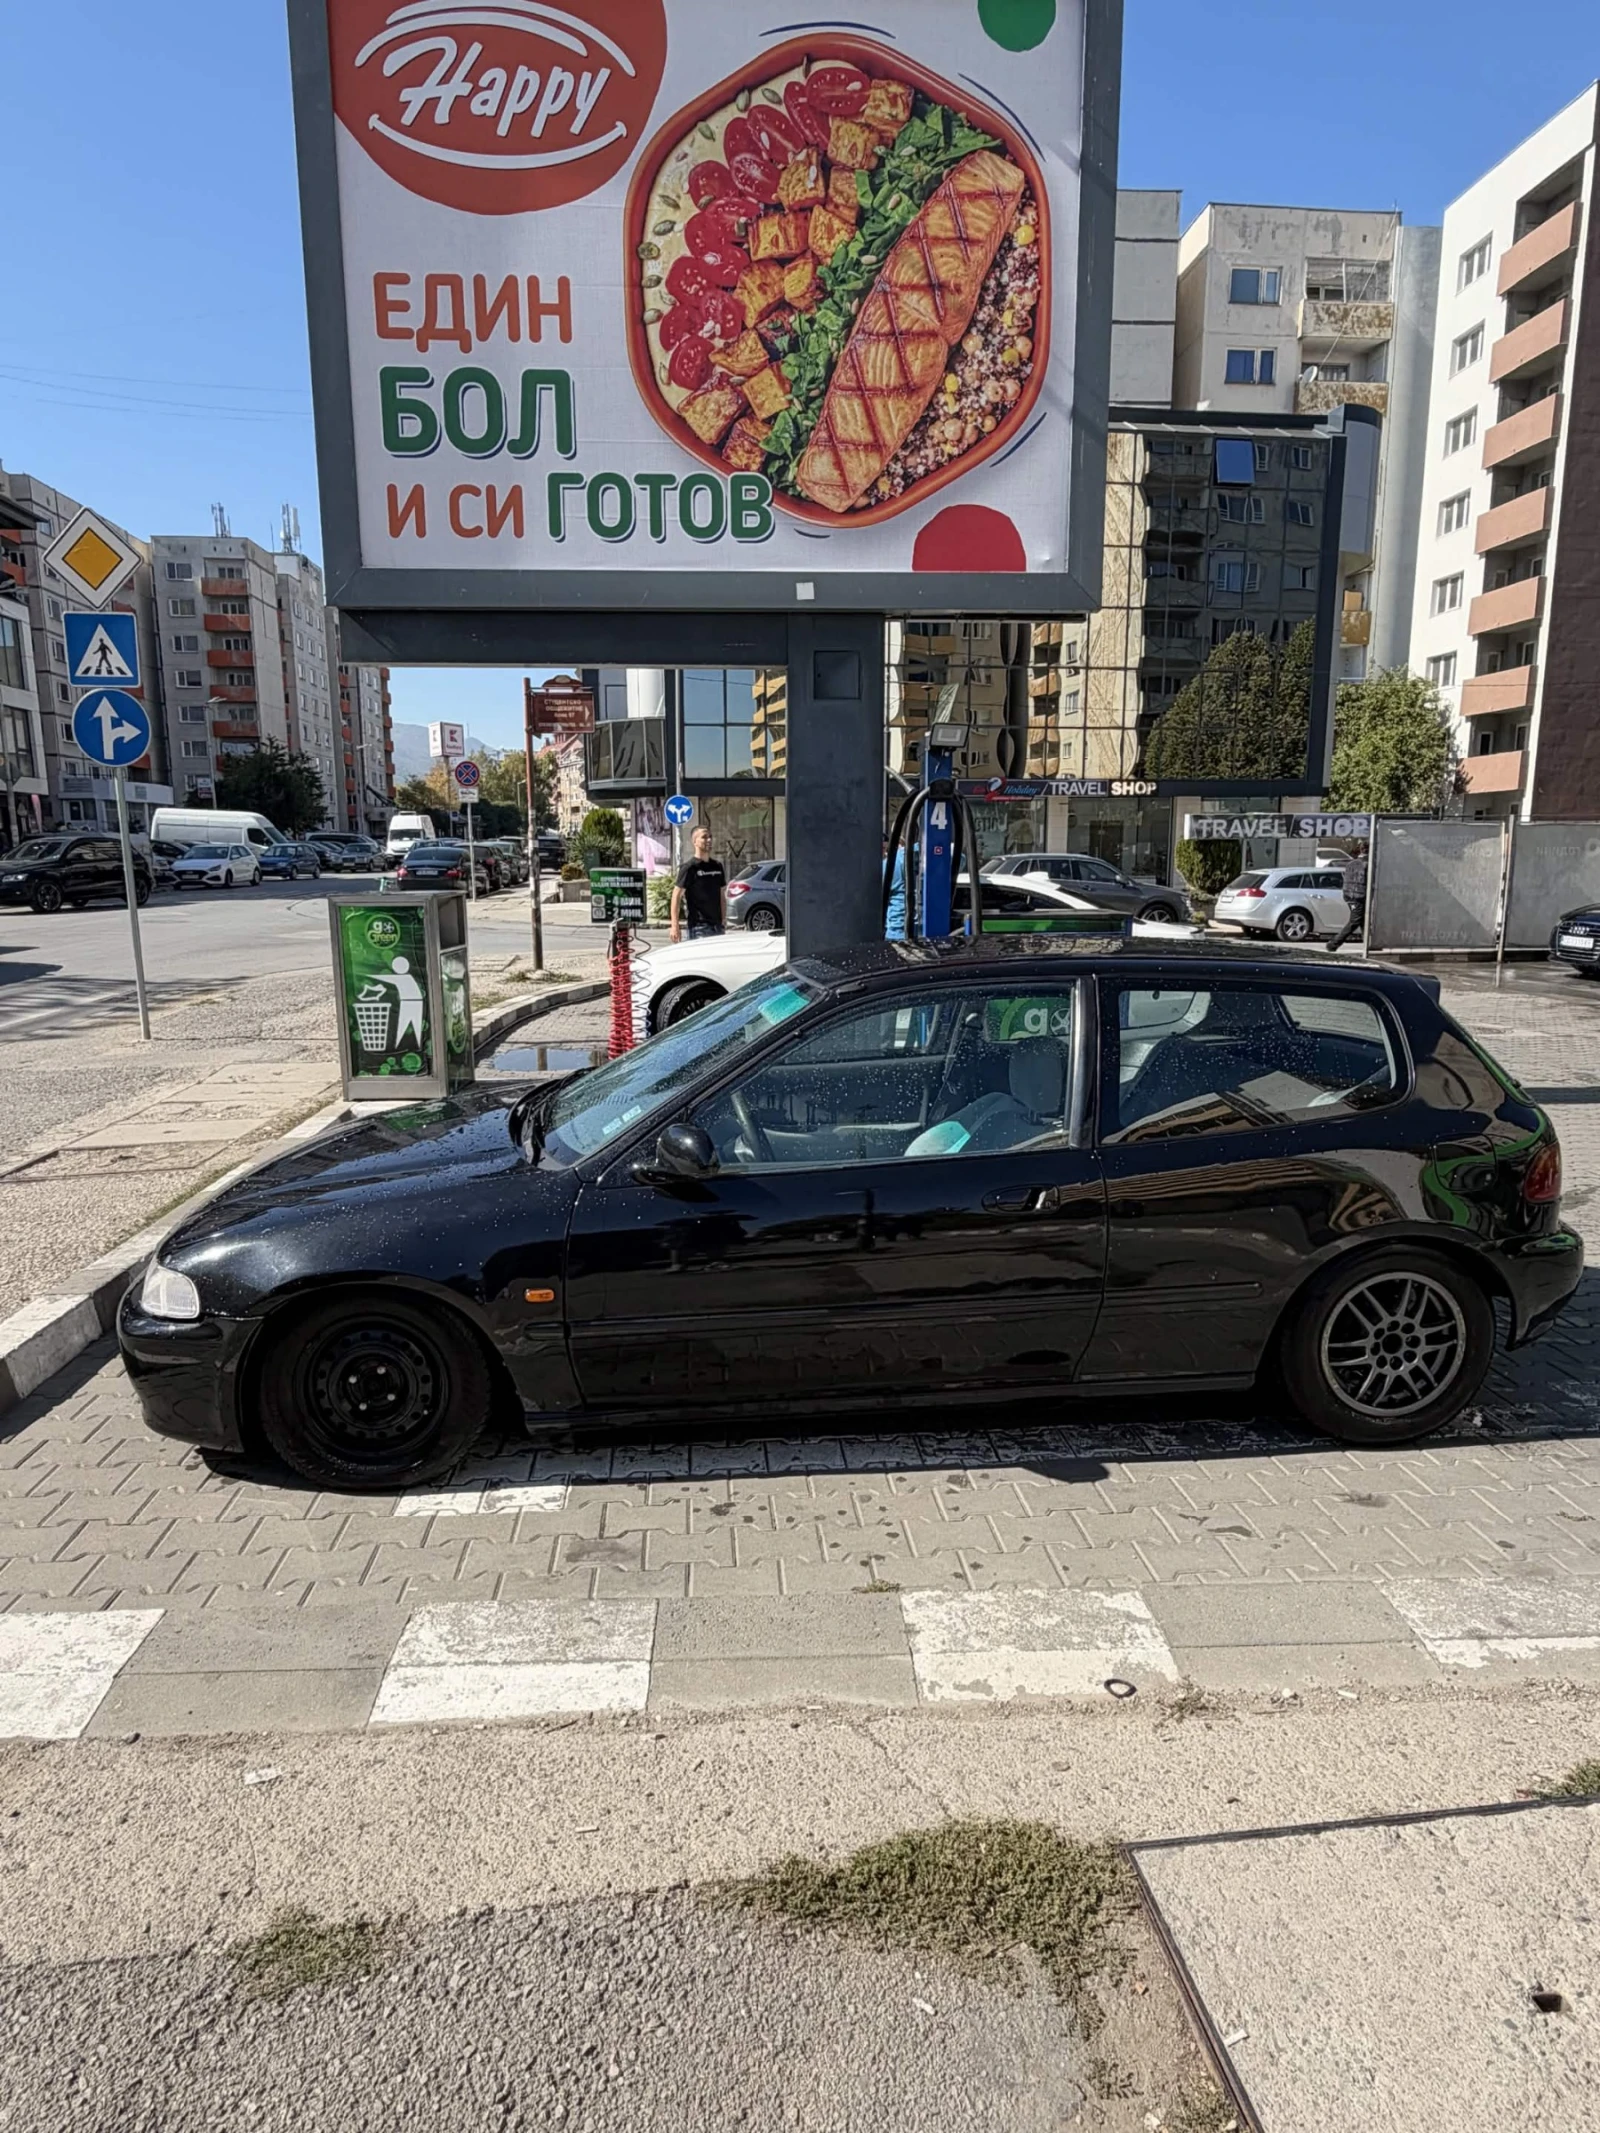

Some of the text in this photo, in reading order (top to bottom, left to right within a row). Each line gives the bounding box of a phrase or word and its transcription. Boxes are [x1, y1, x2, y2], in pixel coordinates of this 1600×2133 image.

[383, 35, 611, 138] Happy
[373, 271, 573, 353] ЕДИН
[379, 366, 575, 458] БОЛ
[386, 472, 776, 543] И СИ ГОТОВ
[930, 802, 948, 830] 4
[1051, 782, 1106, 795] TRAVEL
[1111, 782, 1157, 795] SHOP
[1198, 817, 1370, 838] TRAVEL SHOP
